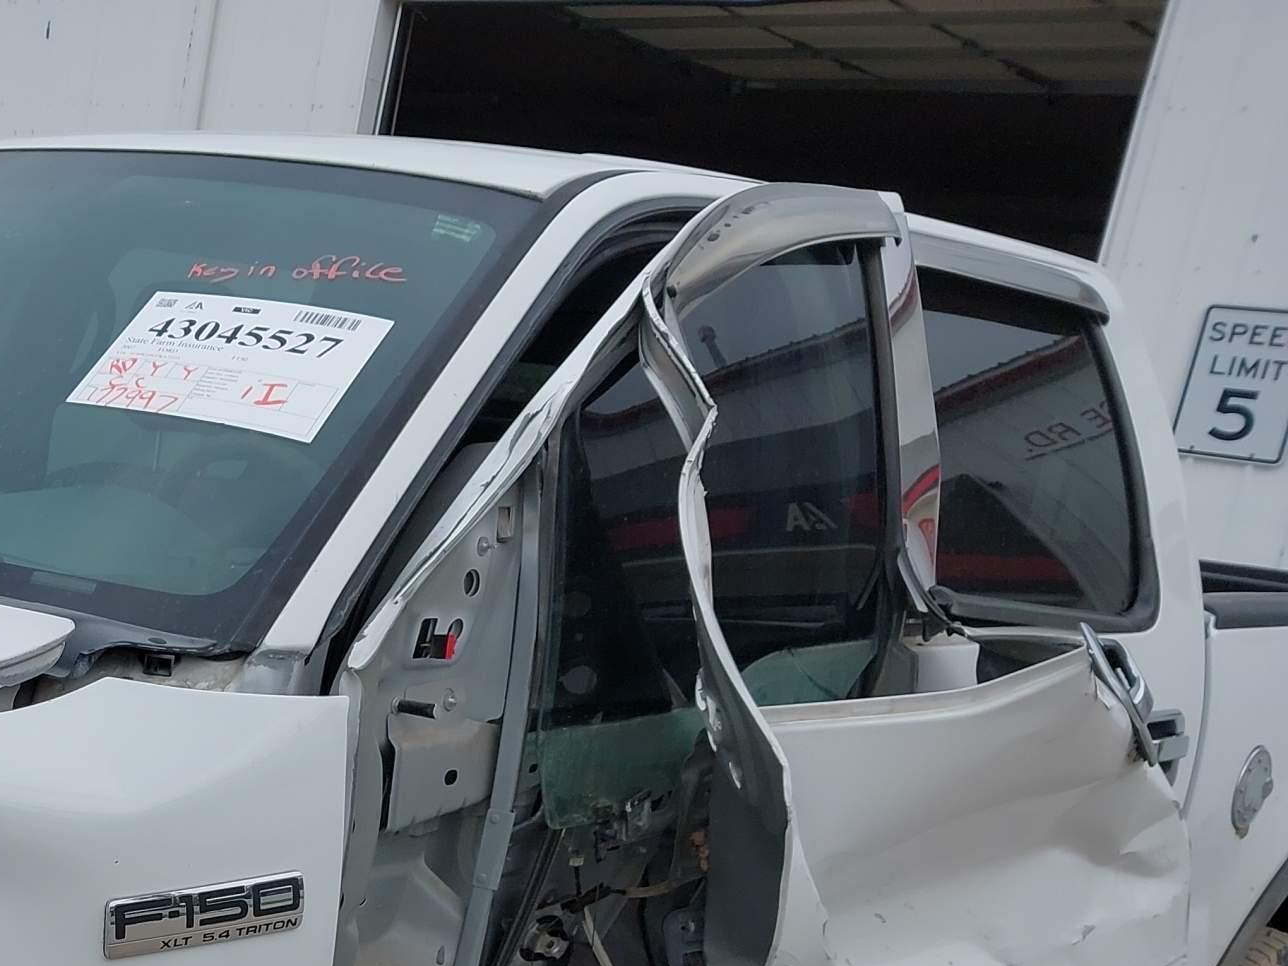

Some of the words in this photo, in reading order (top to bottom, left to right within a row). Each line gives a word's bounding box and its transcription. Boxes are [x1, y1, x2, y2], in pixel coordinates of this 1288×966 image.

[247, 261, 276, 278] in
[291, 254, 408, 282] office
[148, 317, 344, 359] 43045527
[150, 337, 176, 347] Farm
[1209, 321, 1288, 348] SPEE
[1209, 354, 1288, 381] LIMIT
[1207, 387, 1261, 441] 5
[113, 876, 302, 940] F-150
[160, 936, 193, 950] XLT
[202, 930, 231, 943] 5.4
[235, 917, 298, 937] TRITON
